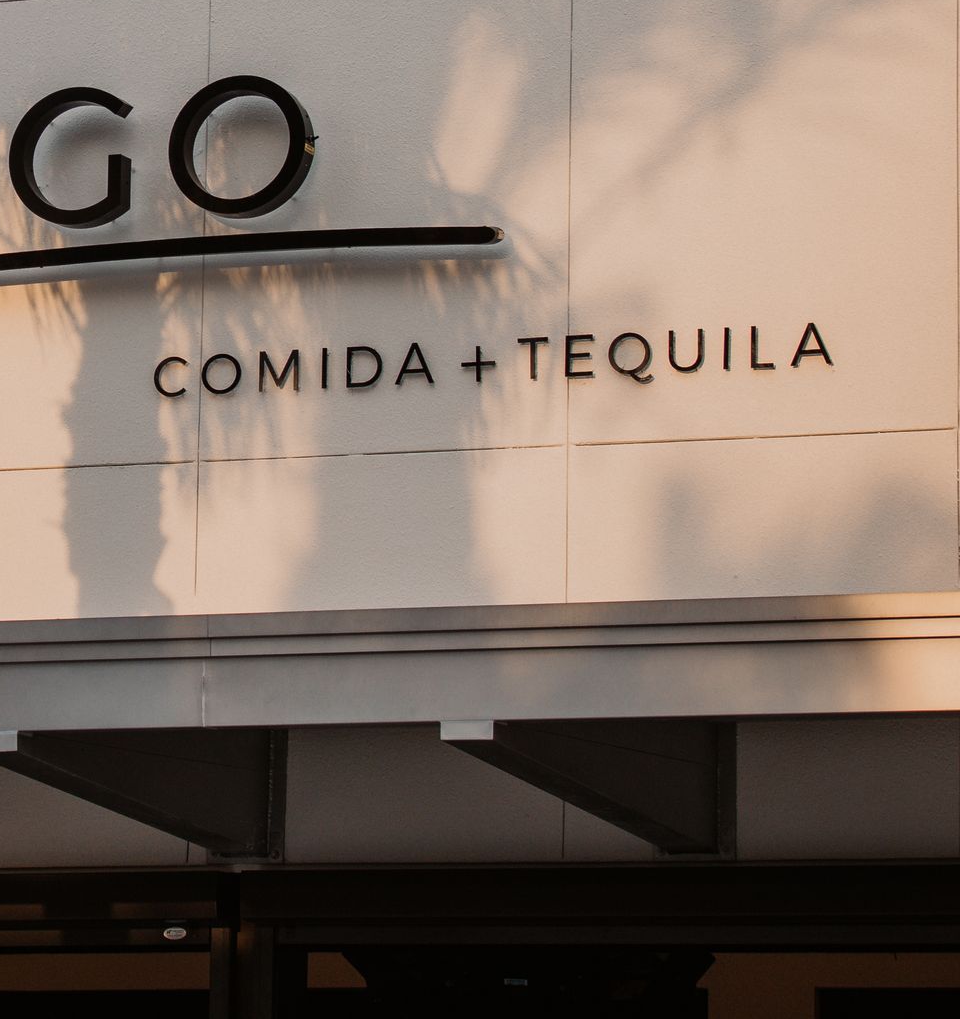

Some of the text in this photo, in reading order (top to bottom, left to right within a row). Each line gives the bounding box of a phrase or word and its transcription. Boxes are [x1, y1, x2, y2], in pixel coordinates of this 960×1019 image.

[154, 322, 834, 398] COMIDA + TEQUILA
